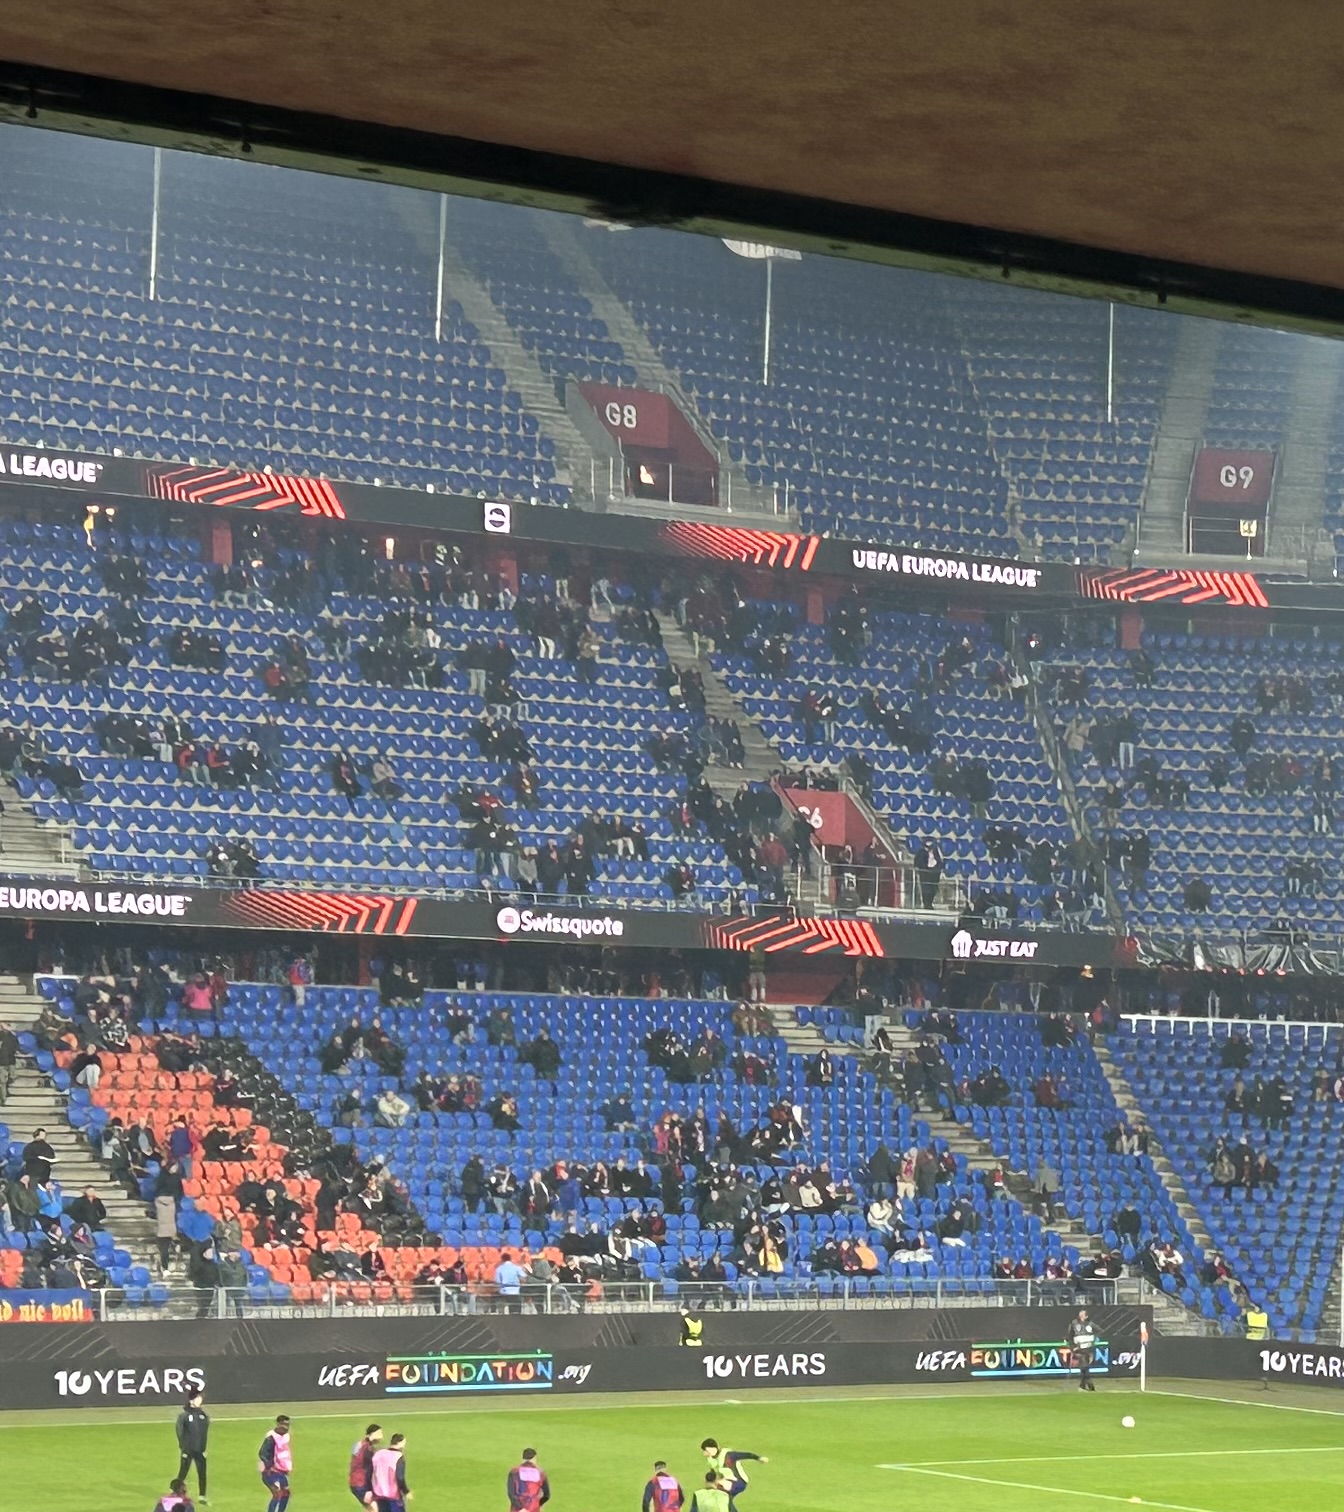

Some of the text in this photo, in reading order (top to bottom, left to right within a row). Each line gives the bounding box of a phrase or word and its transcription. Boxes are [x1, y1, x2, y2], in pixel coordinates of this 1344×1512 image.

[605, 402, 638, 430] G8
[10, 453, 97, 483] LEAGUE
[1219, 463, 1255, 491] G9
[852, 549, 1038, 588] UEFA EUROPA LEAGUE
[0, 886, 186, 917] EUROPA LEAGUE
[520, 909, 624, 939] Swissquote
[973, 939, 1039, 958] JUST EAT
[317, 1363, 380, 1388] UEFA
[385, 1359, 553, 1385] FOUNDATION
[915, 1350, 967, 1371] UEFA
[970, 1347, 1110, 1369] FOUNDATN
